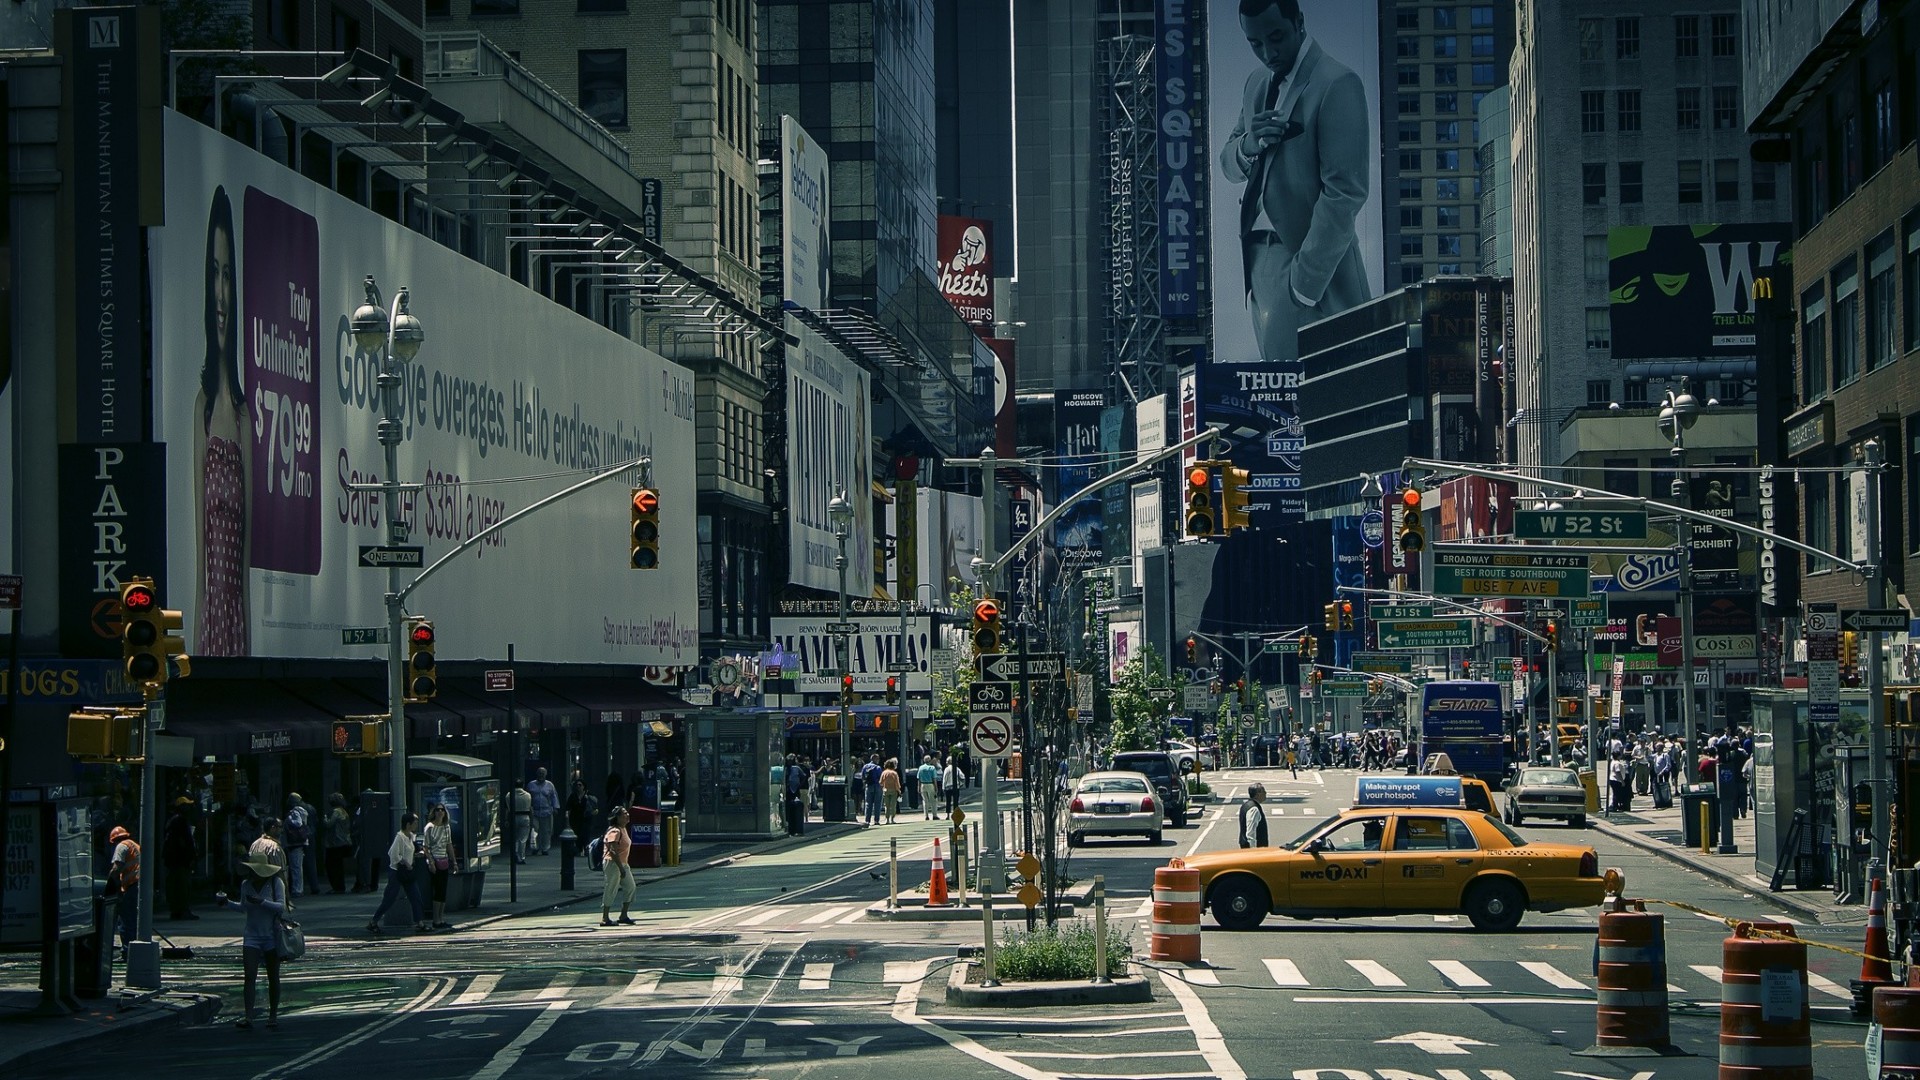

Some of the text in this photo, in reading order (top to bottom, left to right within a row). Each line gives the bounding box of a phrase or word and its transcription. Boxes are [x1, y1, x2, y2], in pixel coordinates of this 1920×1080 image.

[1162, 77, 1192, 270] SQUARE
[1110, 131, 1123, 320] AMERICAN EAGLE
[1121, 158, 1133, 287] OUTFITTERS
[98, 59, 115, 437] THE MANHATTAN AT TIMES SQUARE HOTEL
[1168, 293, 1190, 302] NYC
[289, 281, 311, 331] Truly
[959, 306, 992, 321] STRIPS
[1713, 315, 1735, 325] THE
[253, 317, 312, 383] Unlimited
[1249, 392, 1298, 402] APRIL 28
[1221, 394, 1279, 423] 2011 NFL
[433, 370, 600, 476] overages. Hello endless
[1282, 477, 1300, 487] TO
[338, 448, 506, 558] Save $350 a year.
[92, 448, 128, 593] PARK
[1540, 516, 1623, 534] W 52 St
[1693, 525, 1713, 534] THE
[1759, 464, 1777, 607] McDonald's
[1693, 540, 1733, 549] EXHIBIT
[368, 551, 415, 562] ONE WAY
[1443, 555, 1580, 566] BROADWAY CLOSED AT W 47 ST
[1454, 568, 1567, 579] BEST ROUTE SOUTHBOUND
[1473, 580, 1547, 593] USE 7 AVE
[1383, 608, 1421, 617] W 51 St
[1851, 616, 1900, 625] ONE WAY
[799, 625, 817, 634] BENNY
[860, 624, 880, 633] BJÖRN
[1406, 630, 1443, 638] SOUTHBOUND
[344, 629, 375, 643] W 52 ST
[1404, 639, 1419, 647] LEFT
[1695, 636, 1734, 651] Così
[998, 661, 1057, 674] ONE WAY
[808, 676, 841, 685] SMASH HIT
[1575, 680, 1587, 689] 24
[972, 702, 1010, 711] BIKE PATH
[1439, 699, 1489, 710] STARR
[1365, 783, 1420, 793] Make any spot
[1384, 791, 1418, 800] hotspot.
[634, 824, 651, 832] VOICE
[7, 845, 28, 859] 411
[1300, 864, 1368, 881] NYC TAXI
[564, 1033, 884, 1063] ONLY
